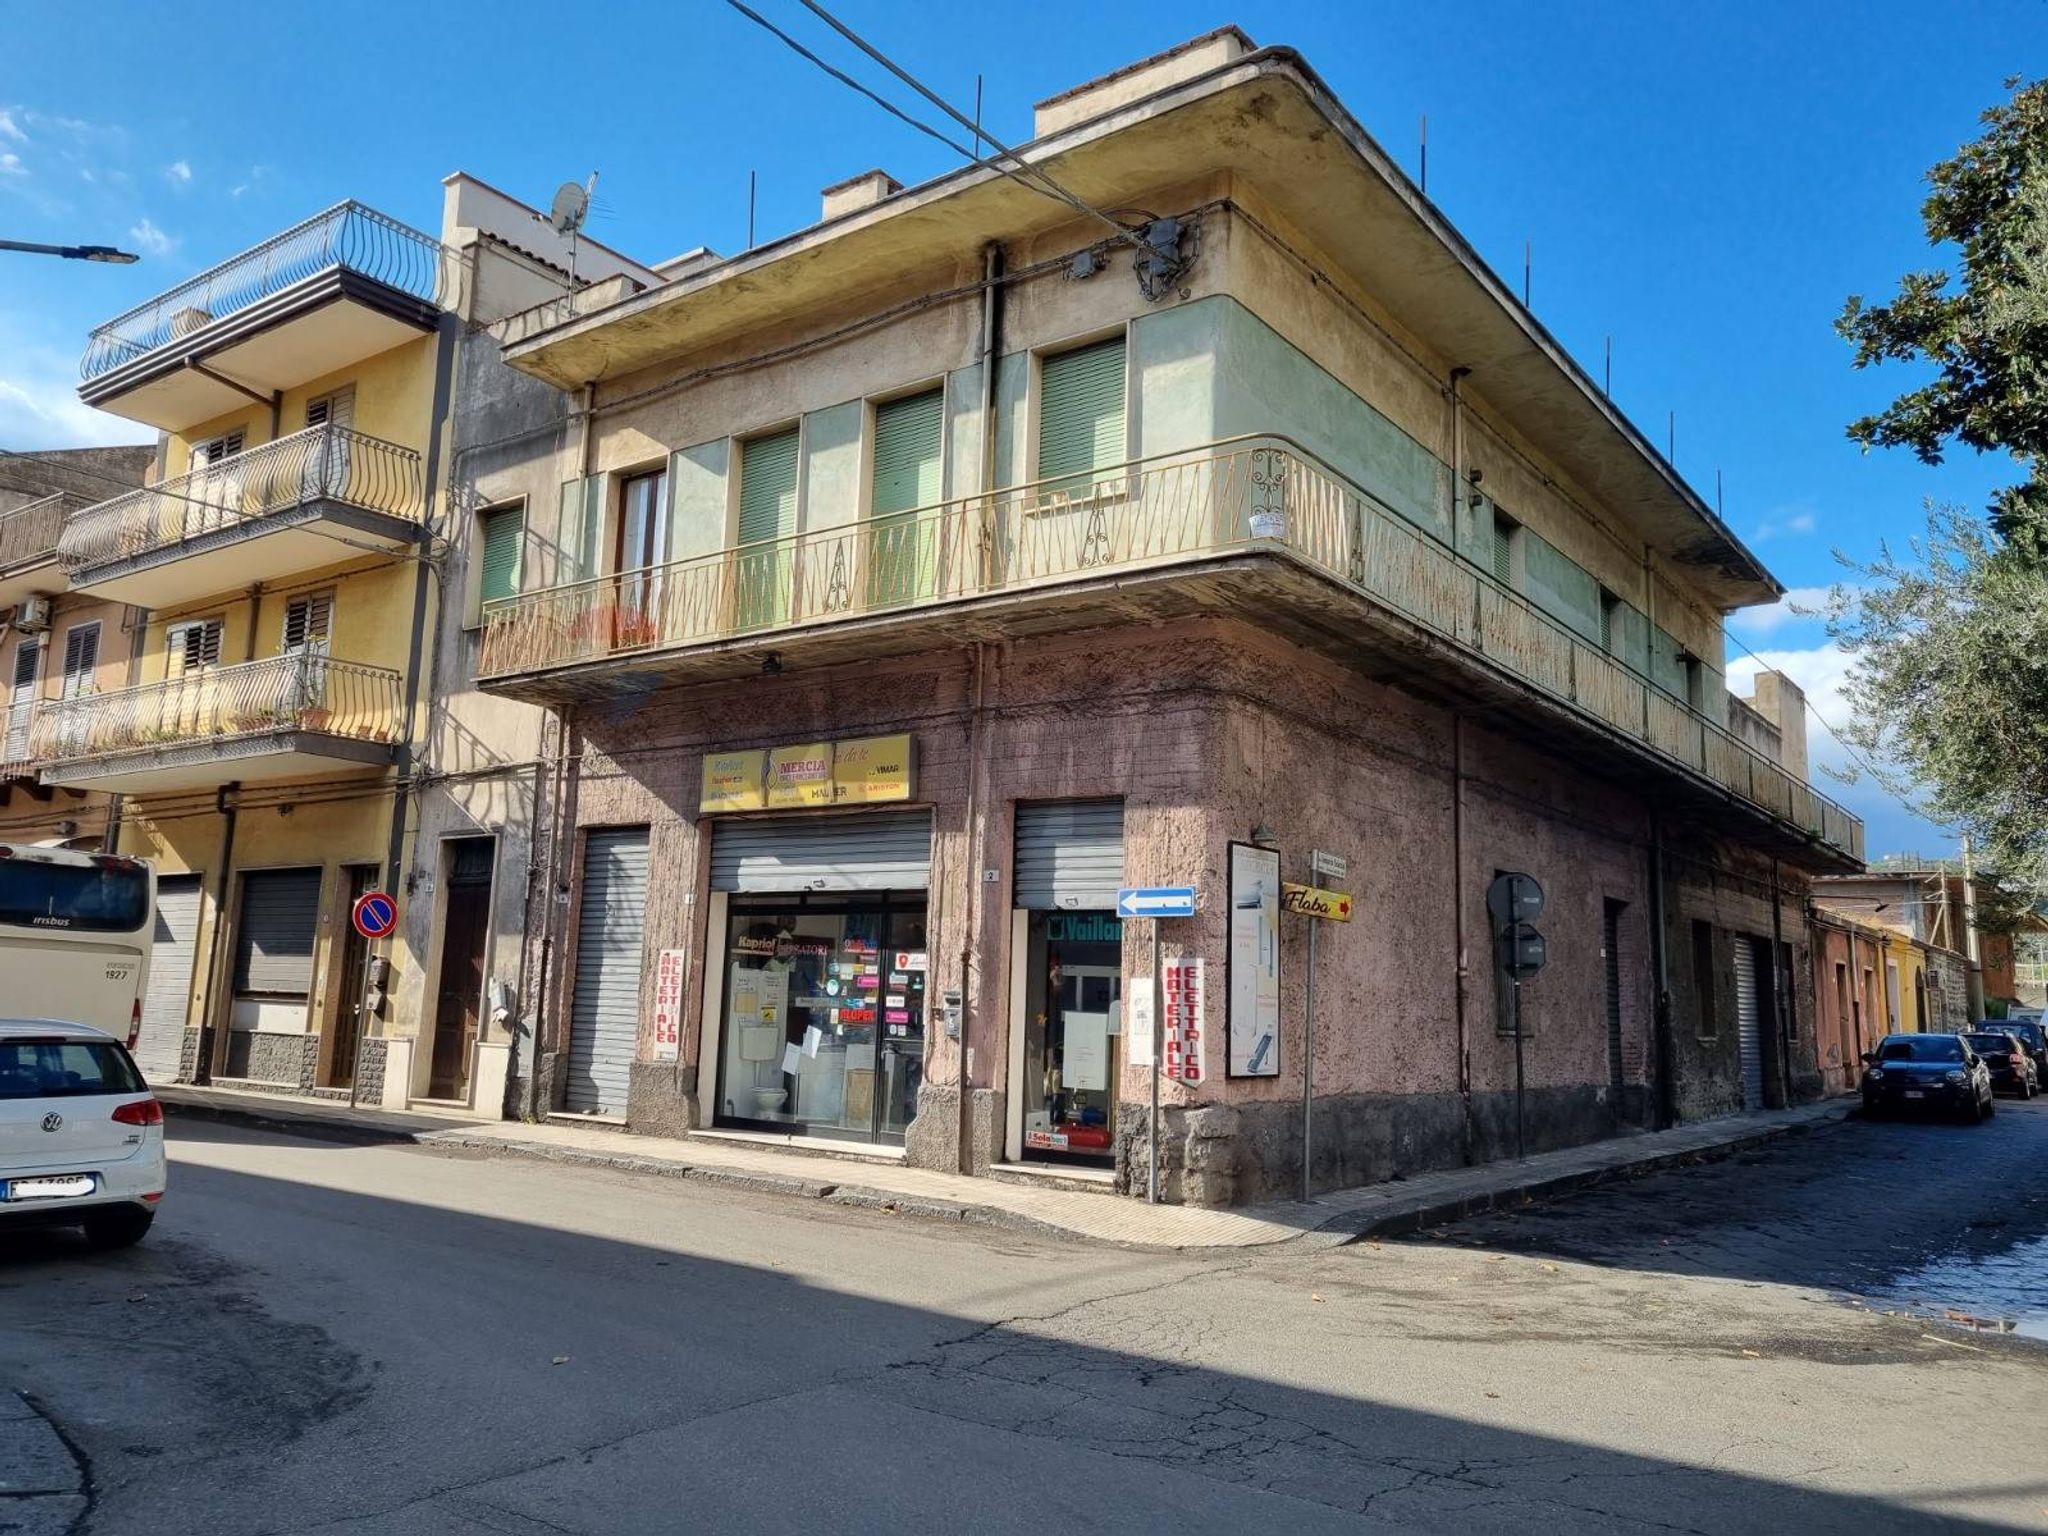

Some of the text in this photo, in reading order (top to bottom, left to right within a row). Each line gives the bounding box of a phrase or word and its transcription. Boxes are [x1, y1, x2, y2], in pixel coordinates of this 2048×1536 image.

[780, 760, 826, 774] MERCIA
[876, 764, 899, 774] VIMAR
[811, 786, 847, 798] MAUER
[1285, 889, 1331, 913] Flaba
[1066, 915, 1121, 941] Vaillan
[738, 935, 776, 949] Kapriol
[105, 970, 128, 980] 1927
[656, 955, 670, 1043] MATERIALE
[1167, 967, 1182, 1080] MATERIALE
[1184, 966, 1200, 1080] ELETTRICO
